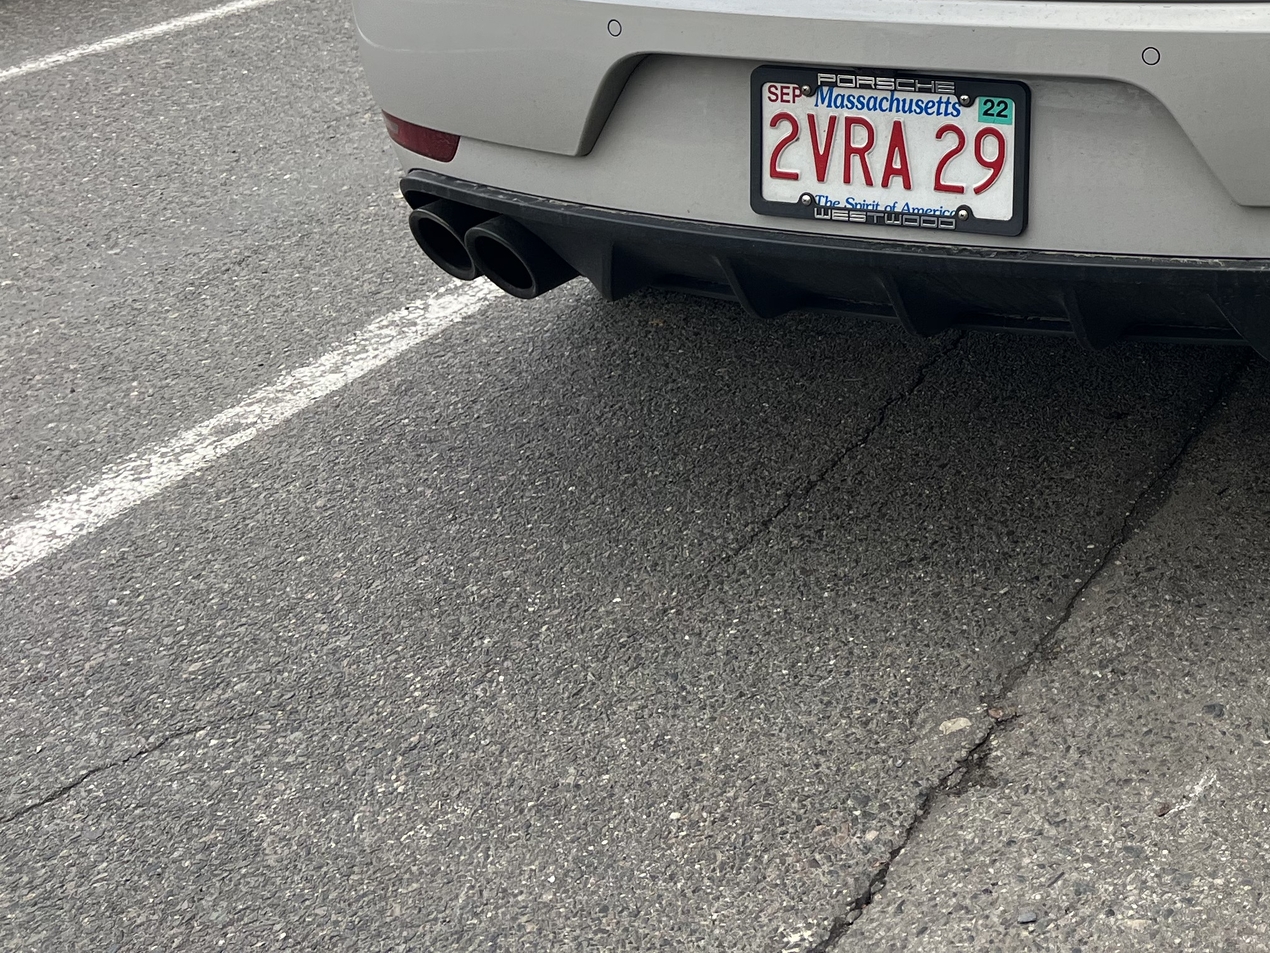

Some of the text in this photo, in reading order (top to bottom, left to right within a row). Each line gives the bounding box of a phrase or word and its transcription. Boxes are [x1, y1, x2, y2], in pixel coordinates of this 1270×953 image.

[767, 84, 802, 103] SEP
[817, 73, 956, 94] PORSCHE
[814, 86, 961, 118] Massachusetts
[982, 99, 1009, 118] 22
[769, 111, 1006, 195] 2VRA 29
[815, 194, 840, 209] The
[845, 196, 881, 212] Spirit
[884, 199, 899, 212] of
[814, 208, 956, 230] WESTWOOD
